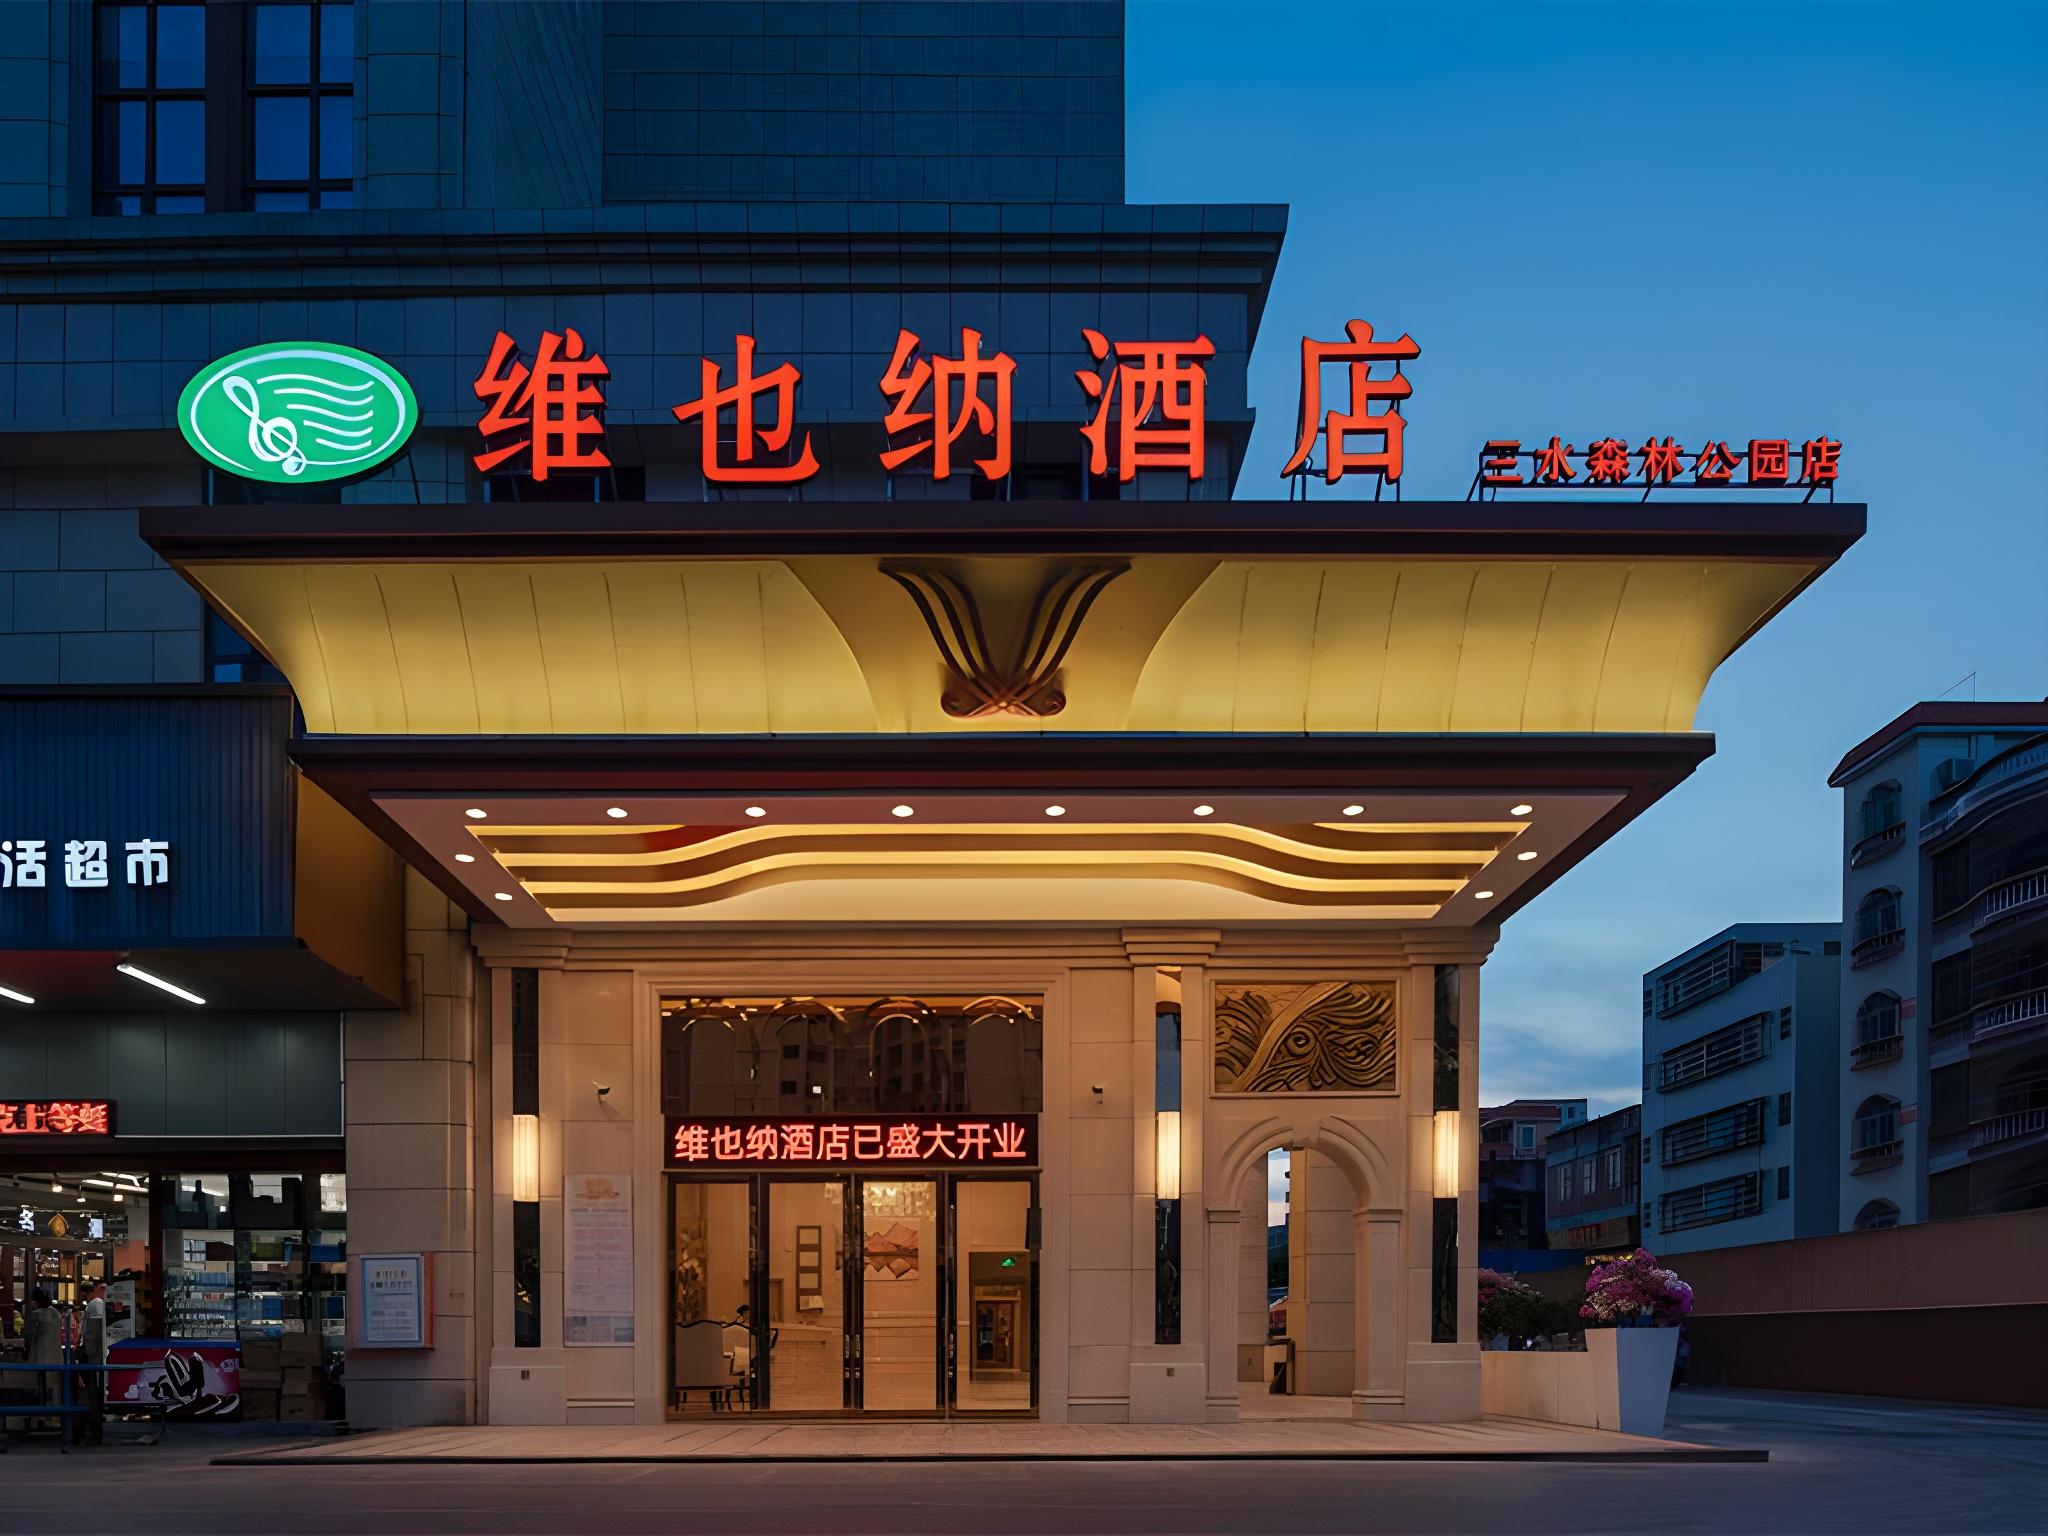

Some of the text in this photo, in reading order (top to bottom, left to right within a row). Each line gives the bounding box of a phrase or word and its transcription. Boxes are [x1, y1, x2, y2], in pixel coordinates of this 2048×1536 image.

[473, 319, 1421, 485] 维也纳酒店
[1484, 435, 1843, 484] 三水森林公园店
[674, 1122, 1027, 1162] 维也纳酒店已盛大开业
